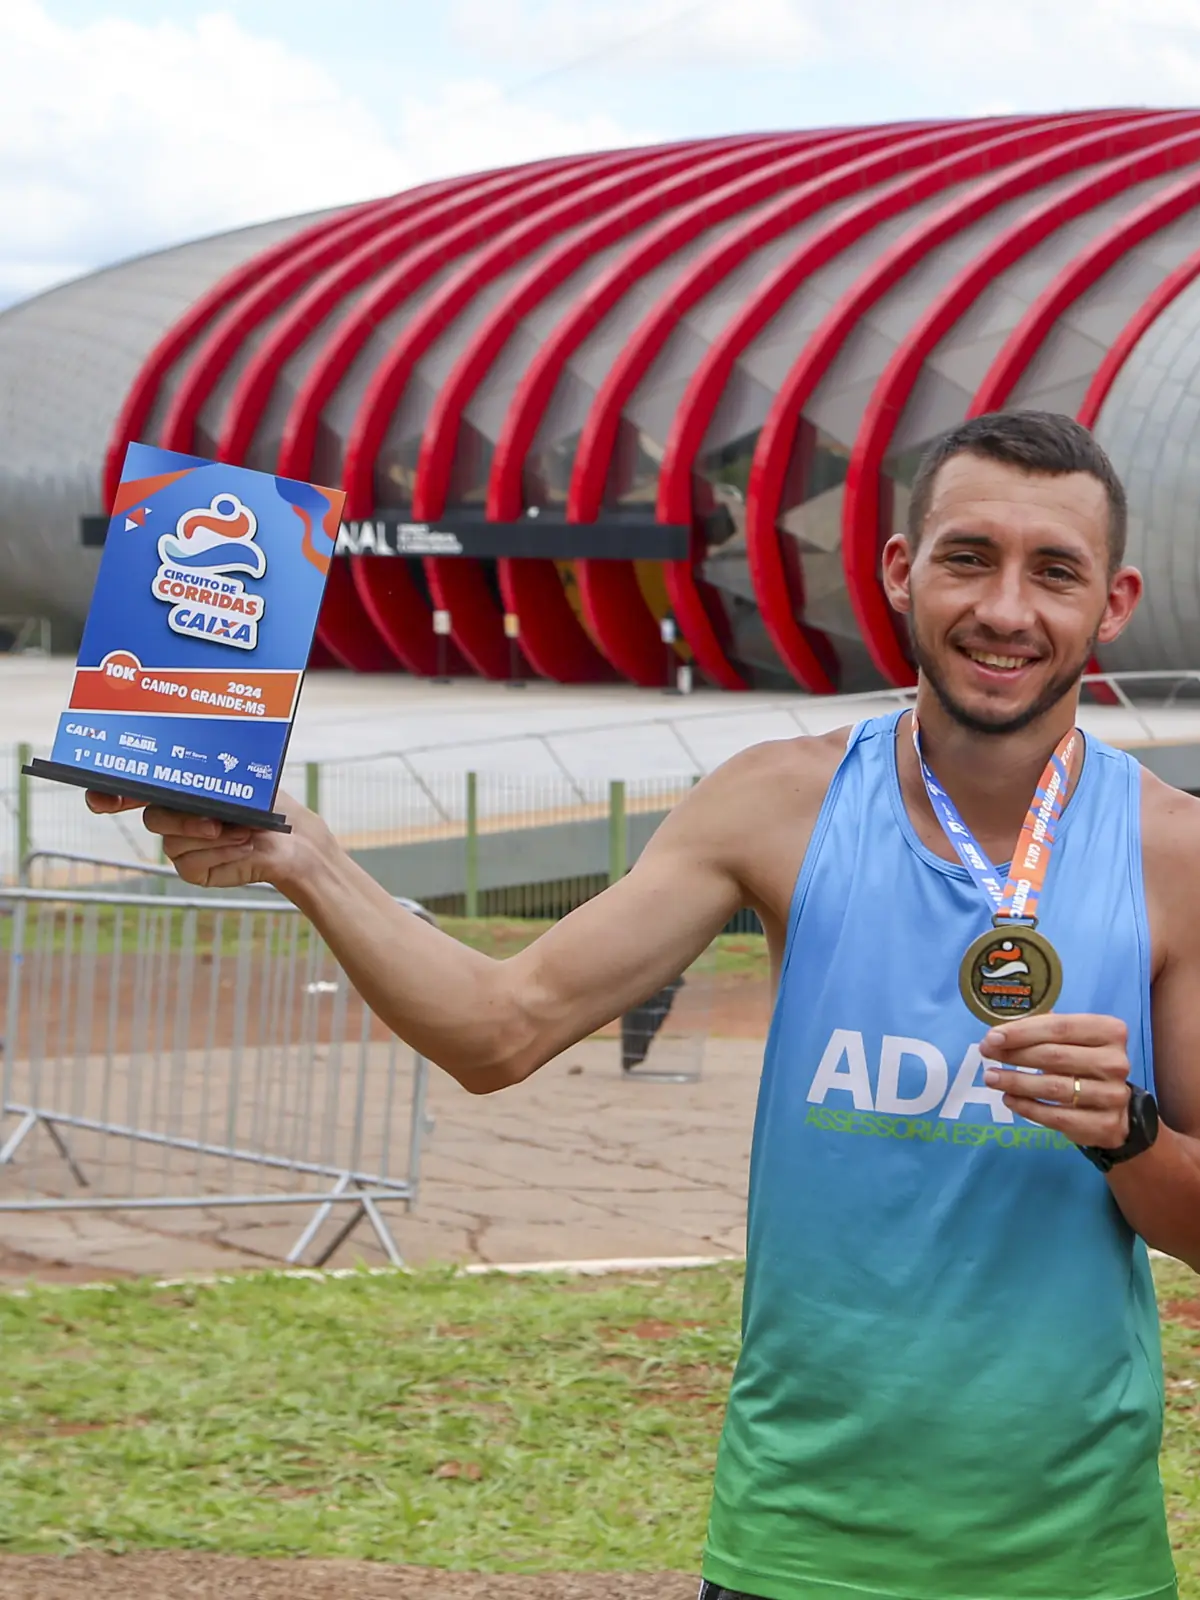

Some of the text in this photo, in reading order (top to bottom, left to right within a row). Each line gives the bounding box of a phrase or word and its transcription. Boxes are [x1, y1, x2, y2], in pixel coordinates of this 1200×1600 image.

[159, 580, 257, 616] CORRIDAS
[164, 569, 237, 594] CIRCUITO DE
[175, 609, 251, 643] CAIXA
[106, 663, 137, 681] 10K
[141, 677, 265, 715] CAMPO GRANDE-MS
[227, 682, 262, 698] 2024
[66, 723, 107, 741] CAIXA
[95, 752, 149, 776] LUGAR
[153, 766, 254, 800] MASCULINO
[804, 1106, 949, 1143] ASSESSORIA
